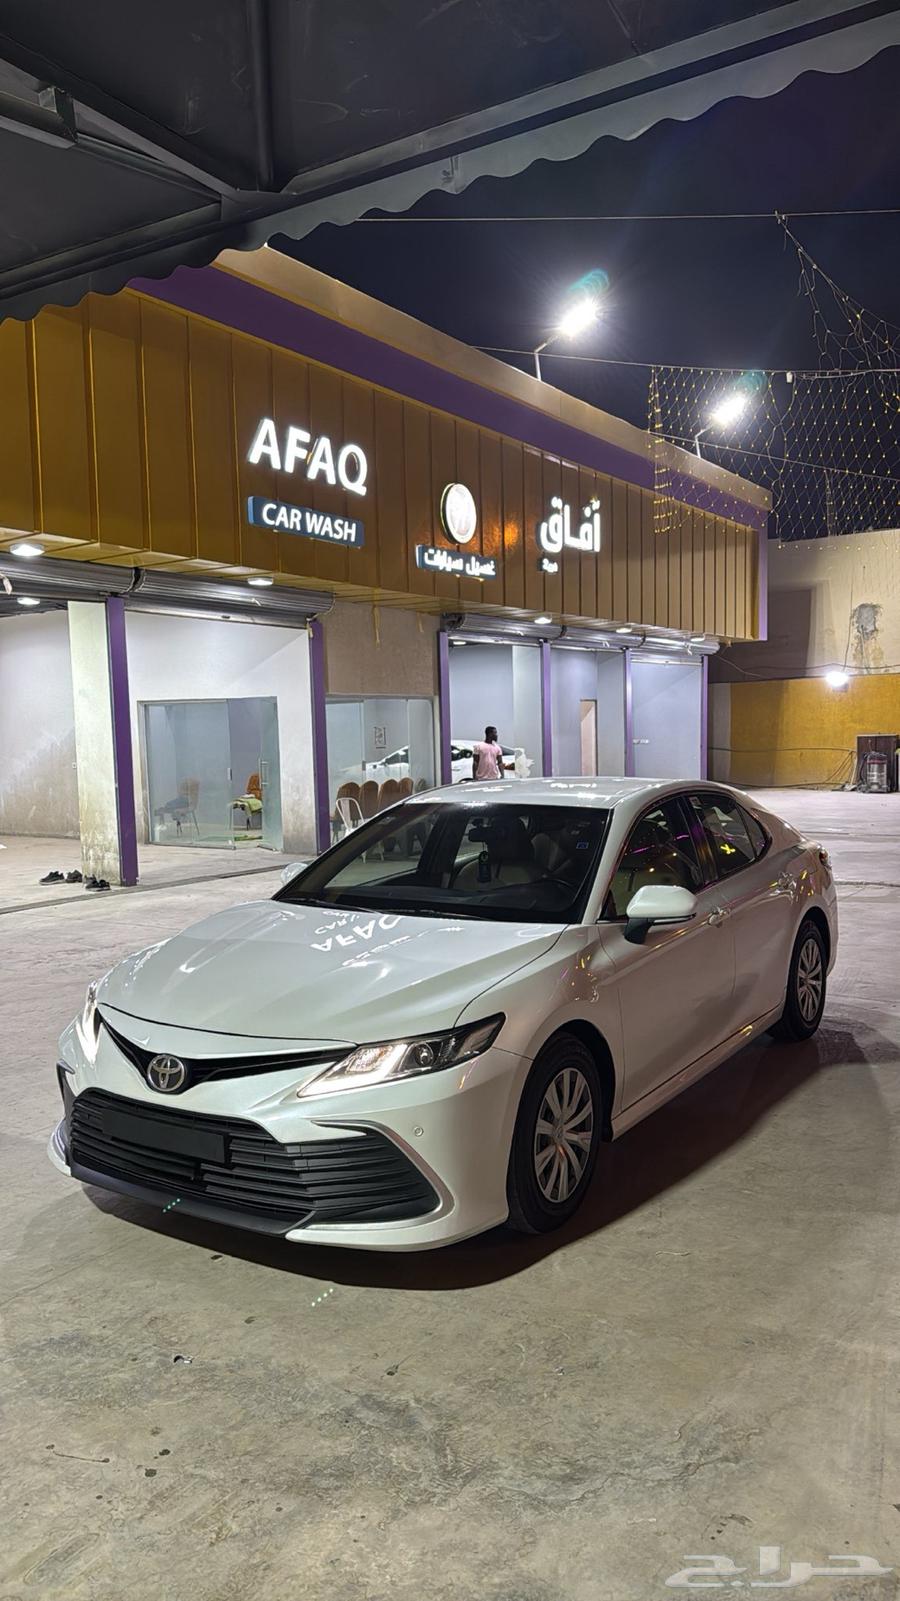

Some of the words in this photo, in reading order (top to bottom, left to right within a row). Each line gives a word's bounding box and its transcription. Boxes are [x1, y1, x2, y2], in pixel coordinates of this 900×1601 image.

[248, 418, 367, 496] AFAQ
[262, 503, 302, 530] CAR
[305, 511, 356, 542] WASH
